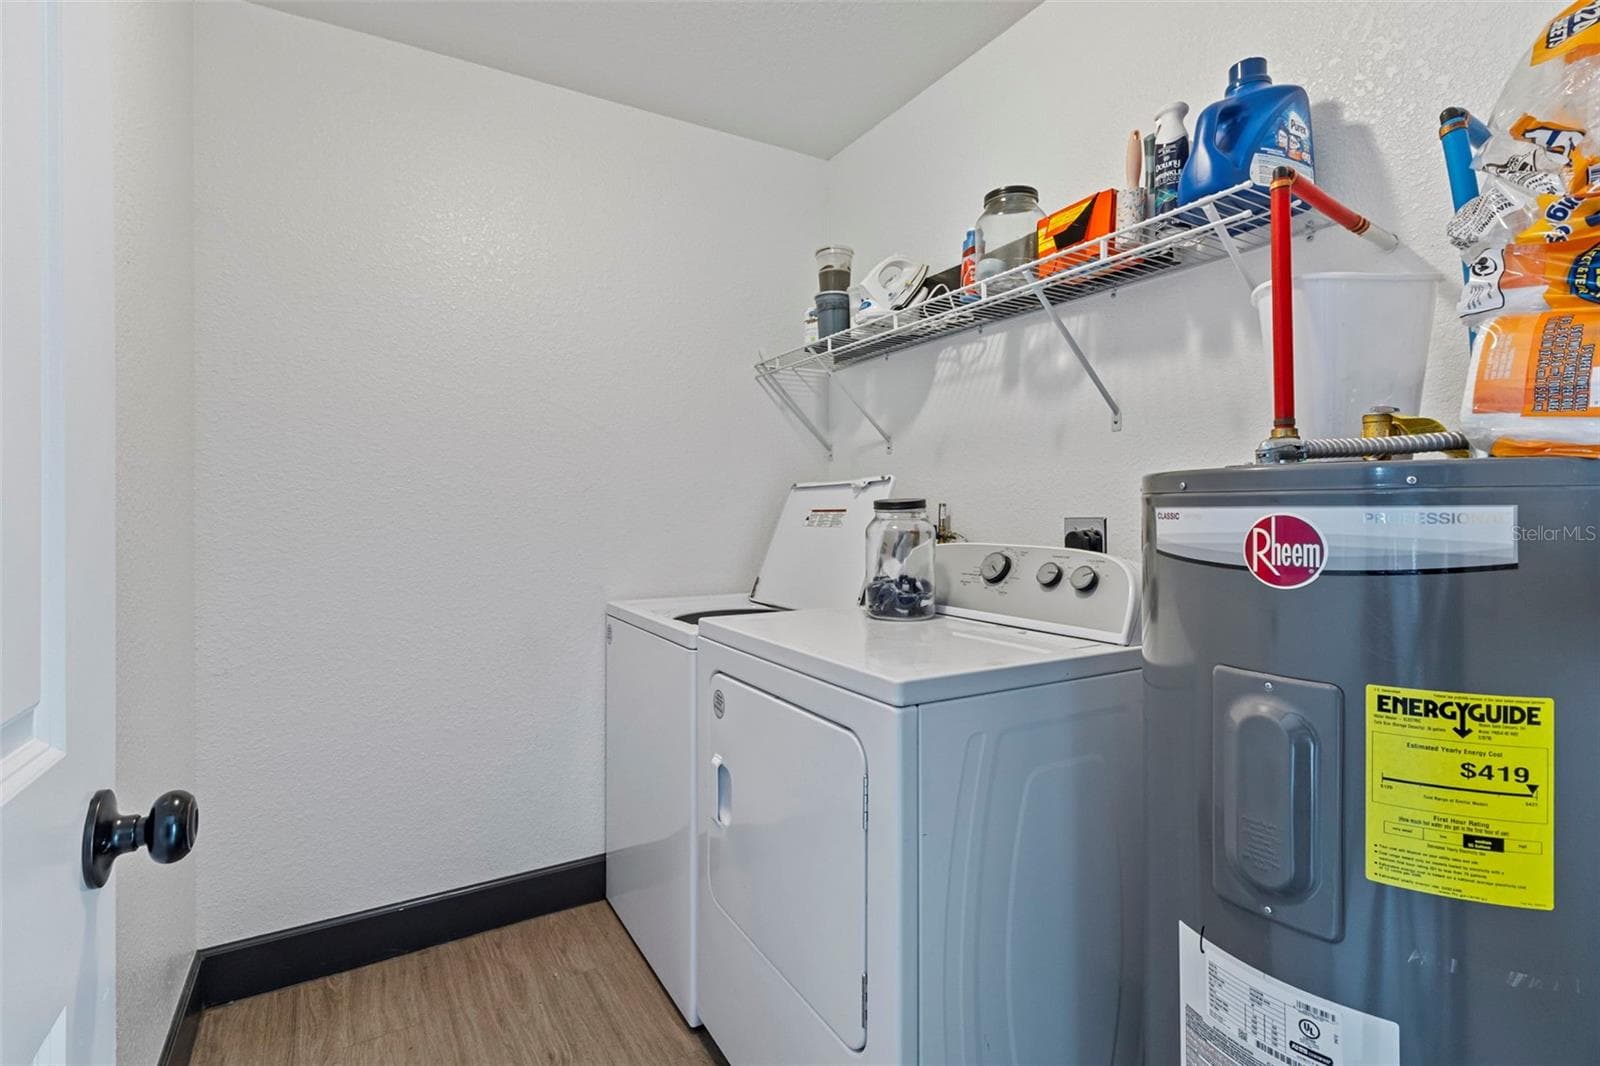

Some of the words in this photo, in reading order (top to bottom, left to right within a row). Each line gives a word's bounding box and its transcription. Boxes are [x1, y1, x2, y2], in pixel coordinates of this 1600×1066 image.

[1155, 159, 1181, 173] Downy
[1158, 512, 1180, 520] CLASSIC
[1252, 516, 1320, 576] Rheem
[1377, 694, 1541, 727] ENERGYGUIDE
[1407, 742, 1438, 752] Estimated
[1441, 747, 1462, 755] Yearly
[1464, 749, 1486, 757] Energy
[1460, 762, 1530, 784] $419
[1468, 820, 1490, 829] Rating
[1303, 1022, 1316, 1037] UL
